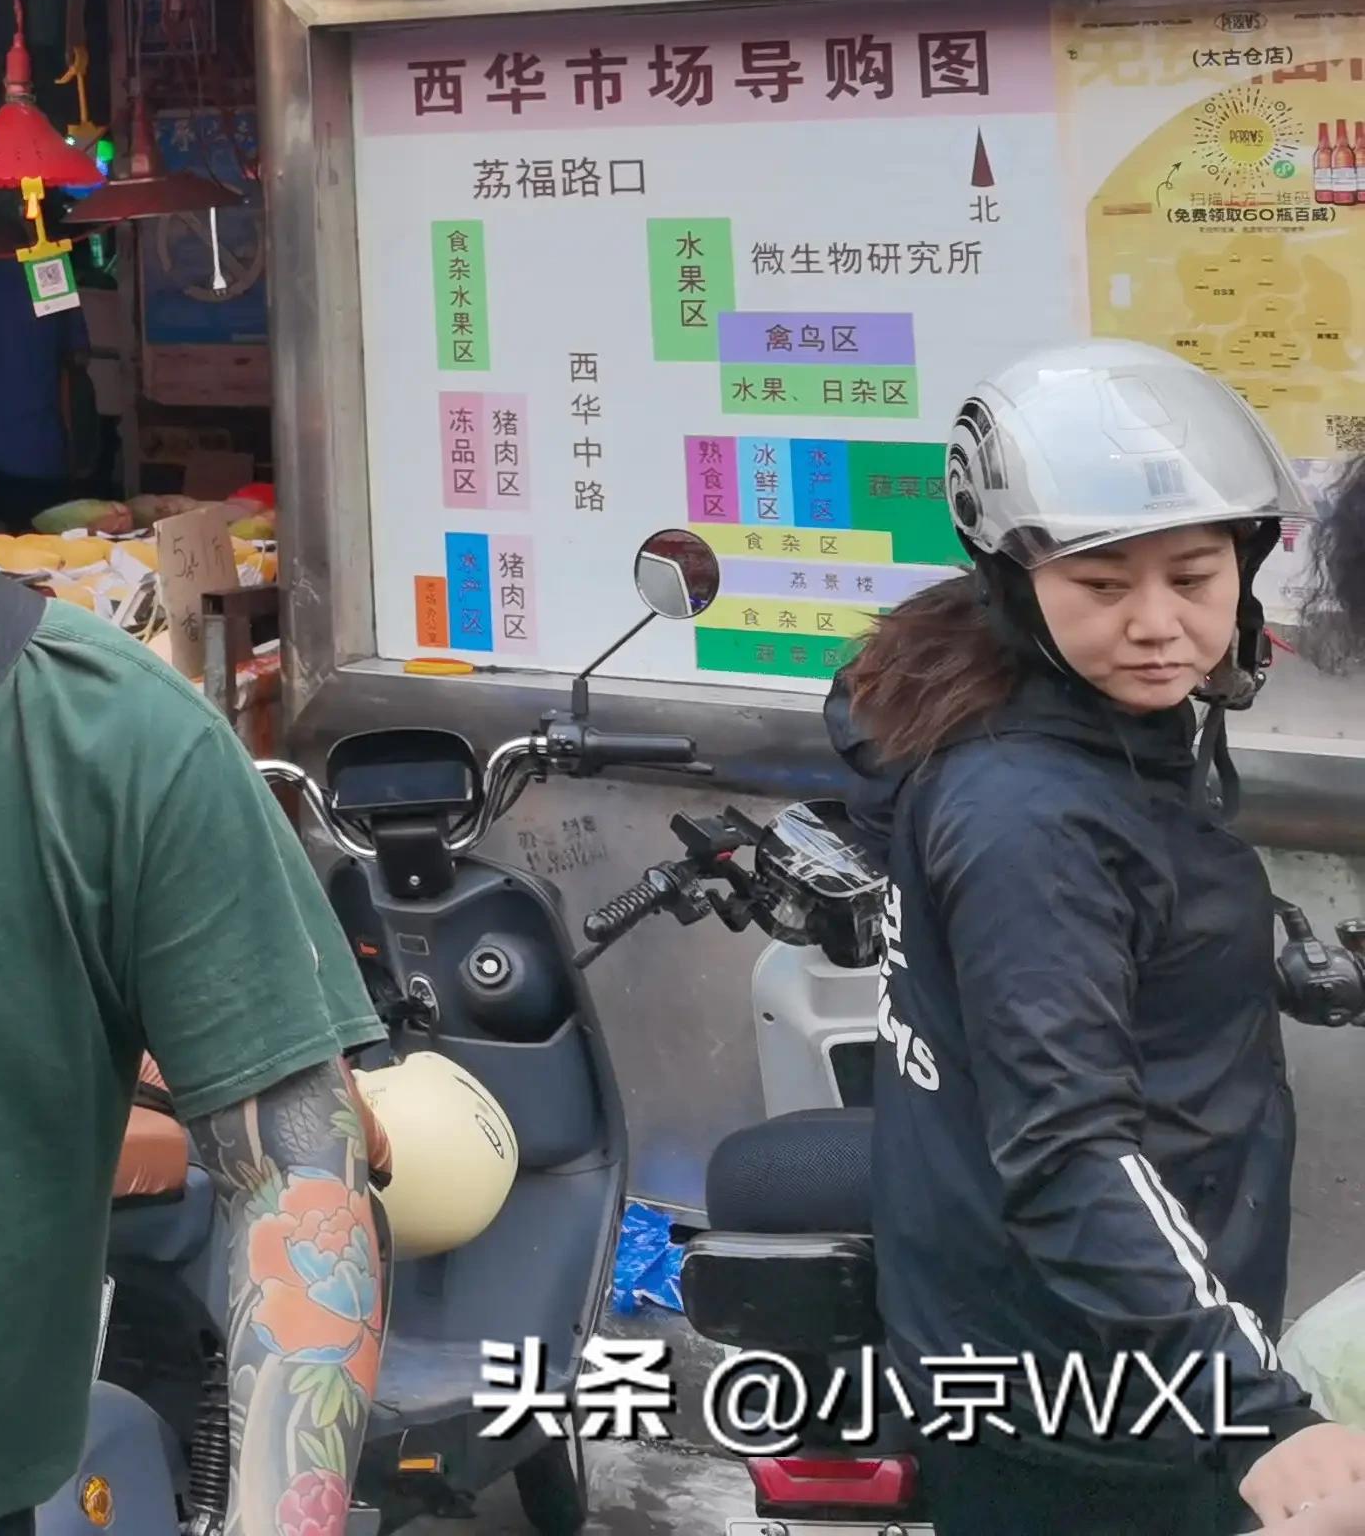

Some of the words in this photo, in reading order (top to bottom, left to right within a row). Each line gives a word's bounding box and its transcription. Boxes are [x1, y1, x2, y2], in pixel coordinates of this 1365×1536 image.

[408, 30, 989, 115] 西华市场导购图
[472, 157, 646, 200] 荔福路口
[969, 195, 1000, 224] 北
[447, 229, 476, 363] 食杂水果区
[675, 230, 709, 327] 水果区
[750, 240, 983, 277] 微生物研究所
[765, 324, 859, 352] 禽鸟区
[732, 377, 909, 405] 水果、日杂区
[449, 408, 477, 495] 冻品区
[492, 409, 521, 496] 猪肉区
[569, 352, 605, 513] 西华中路
[698, 440, 726, 517] 熟食区
[753, 443, 780, 520] 冰鲜区
[808, 447, 836, 522] 水产区
[868, 474, 948, 500] 蔬菜区
[744, 532, 839, 555] 食杂区
[457, 550, 485, 634] 水产区
[498, 552, 527, 640] 猪肉区
[742, 608, 836, 631] 食杂区
[790, 572, 874, 593] 荔景楼
